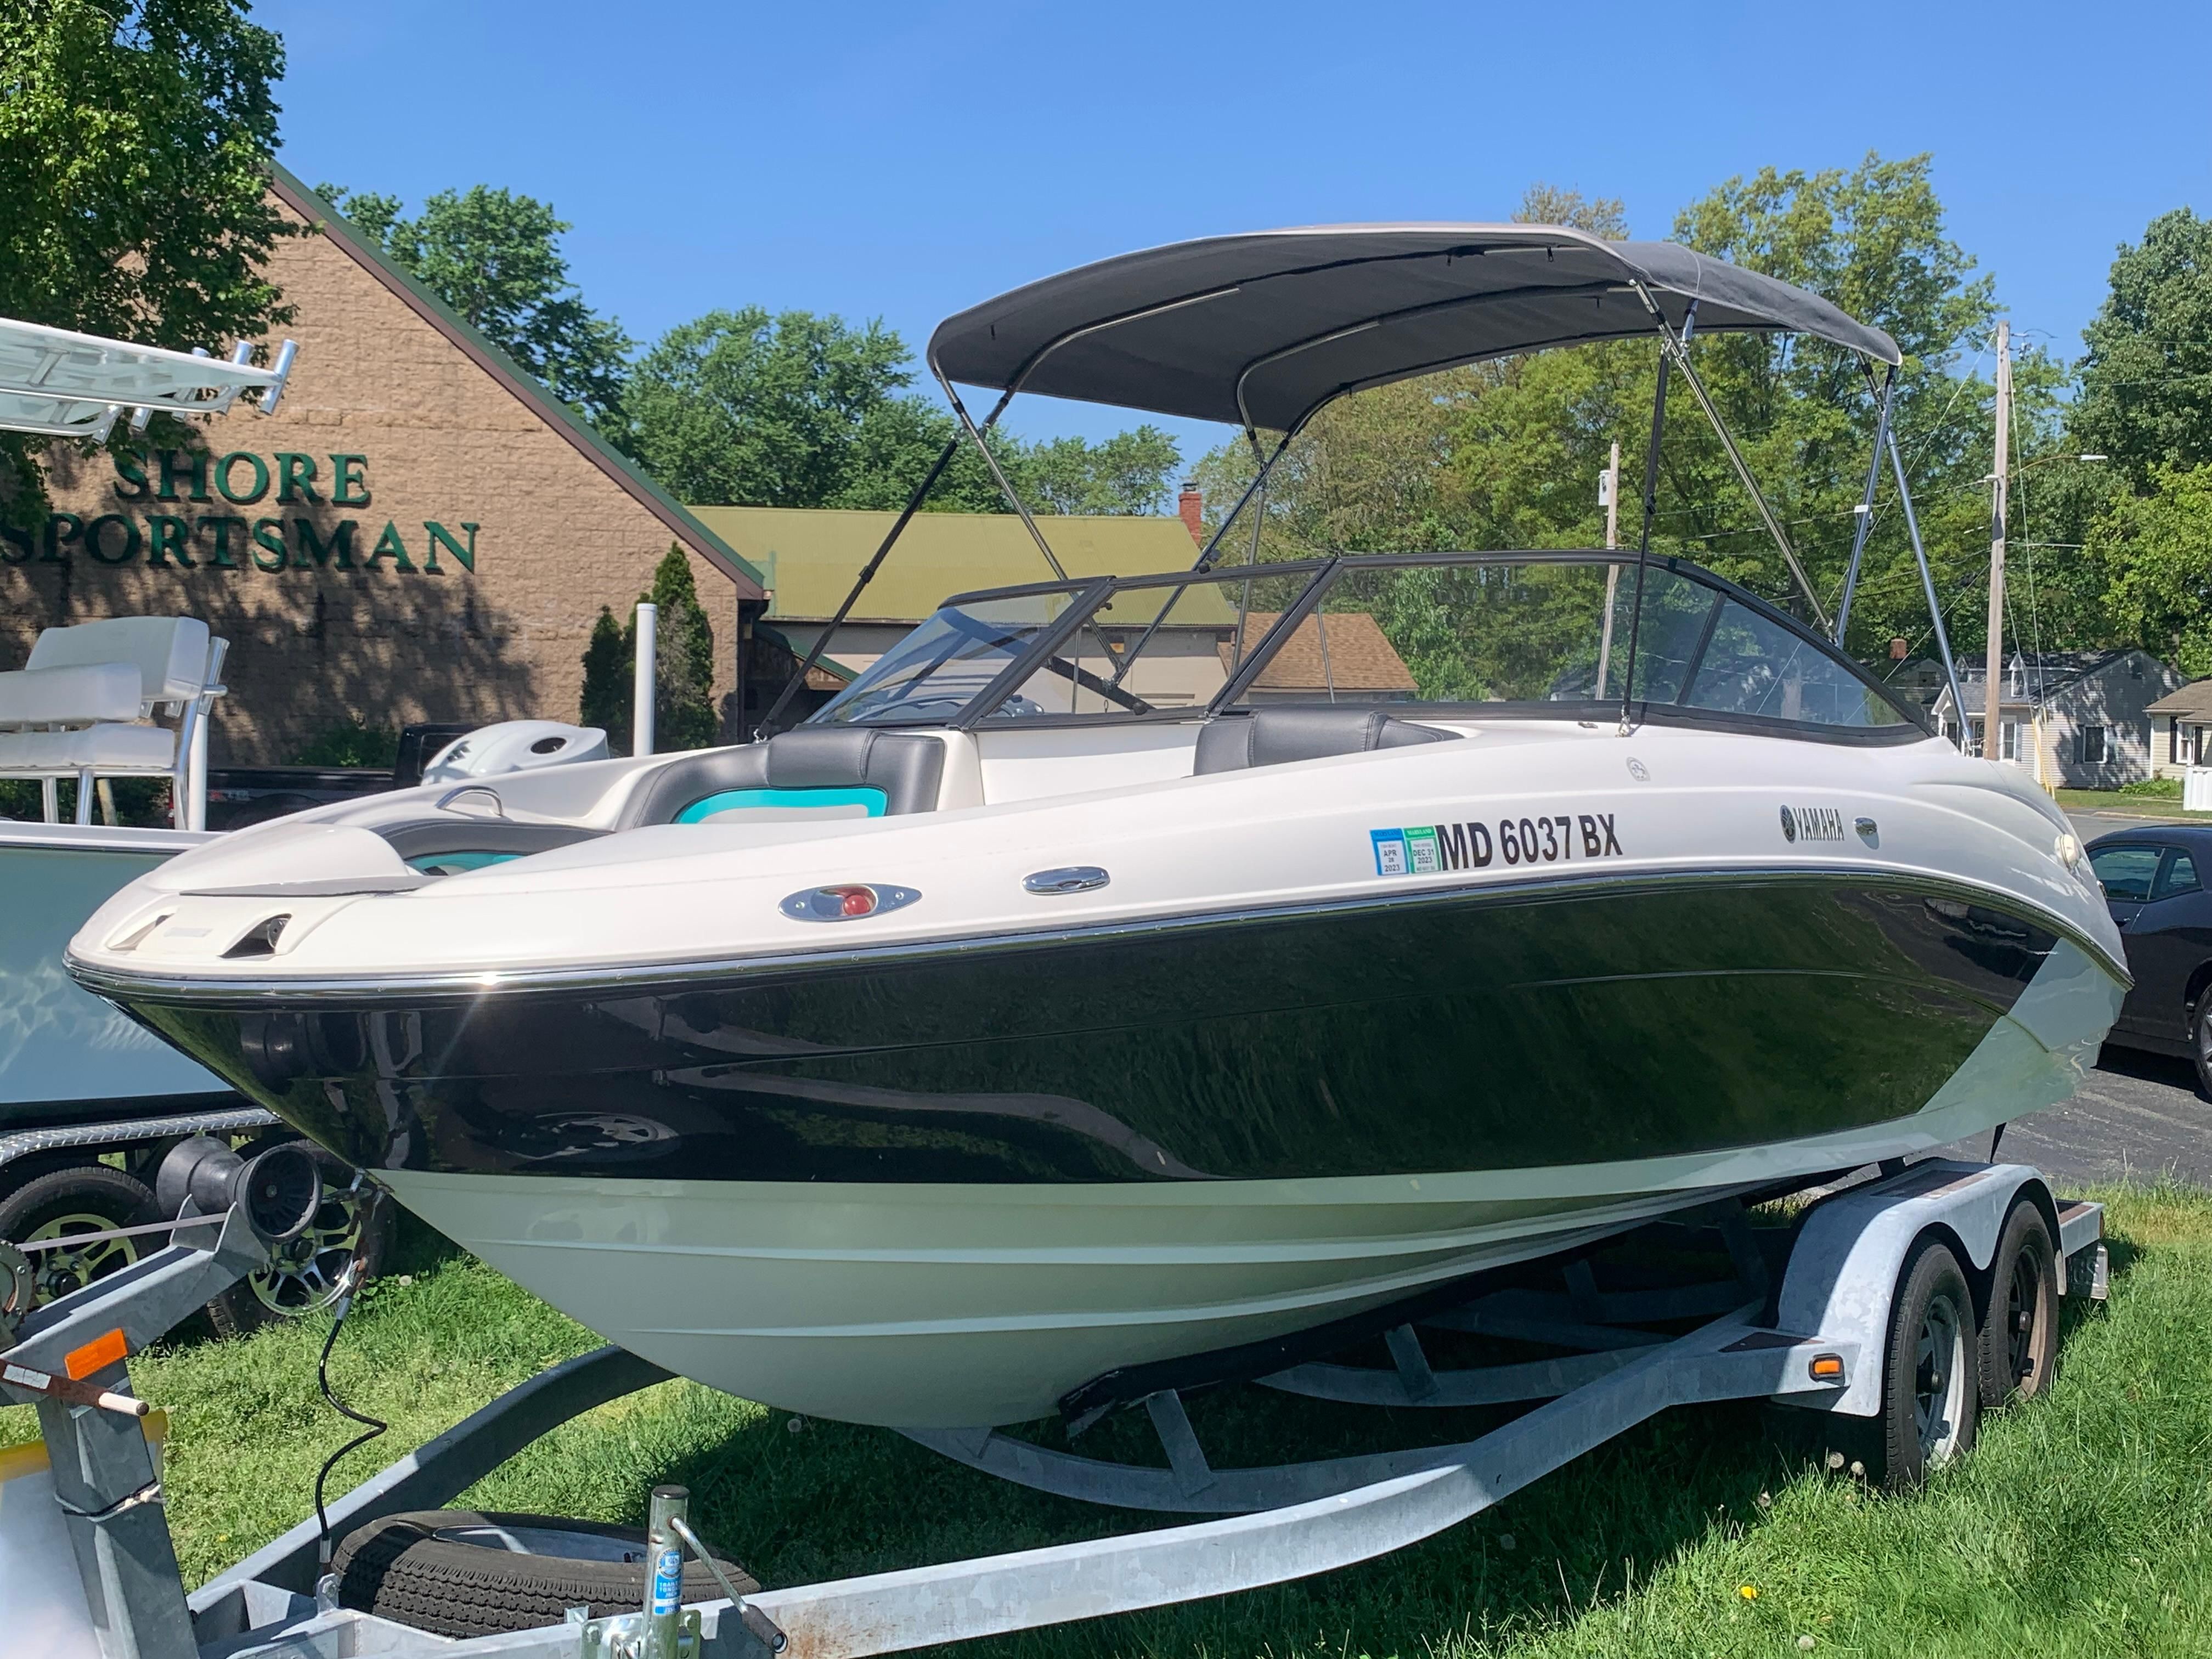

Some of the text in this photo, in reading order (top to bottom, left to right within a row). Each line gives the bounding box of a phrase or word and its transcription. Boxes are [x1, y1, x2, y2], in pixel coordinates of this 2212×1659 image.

[114, 449, 373, 507] SHORE
[0, 512, 481, 575] SPORTSMAN
[1435, 814, 1623, 871] MD 6037 BX
[1792, 807, 1844, 841] YAMAHA
